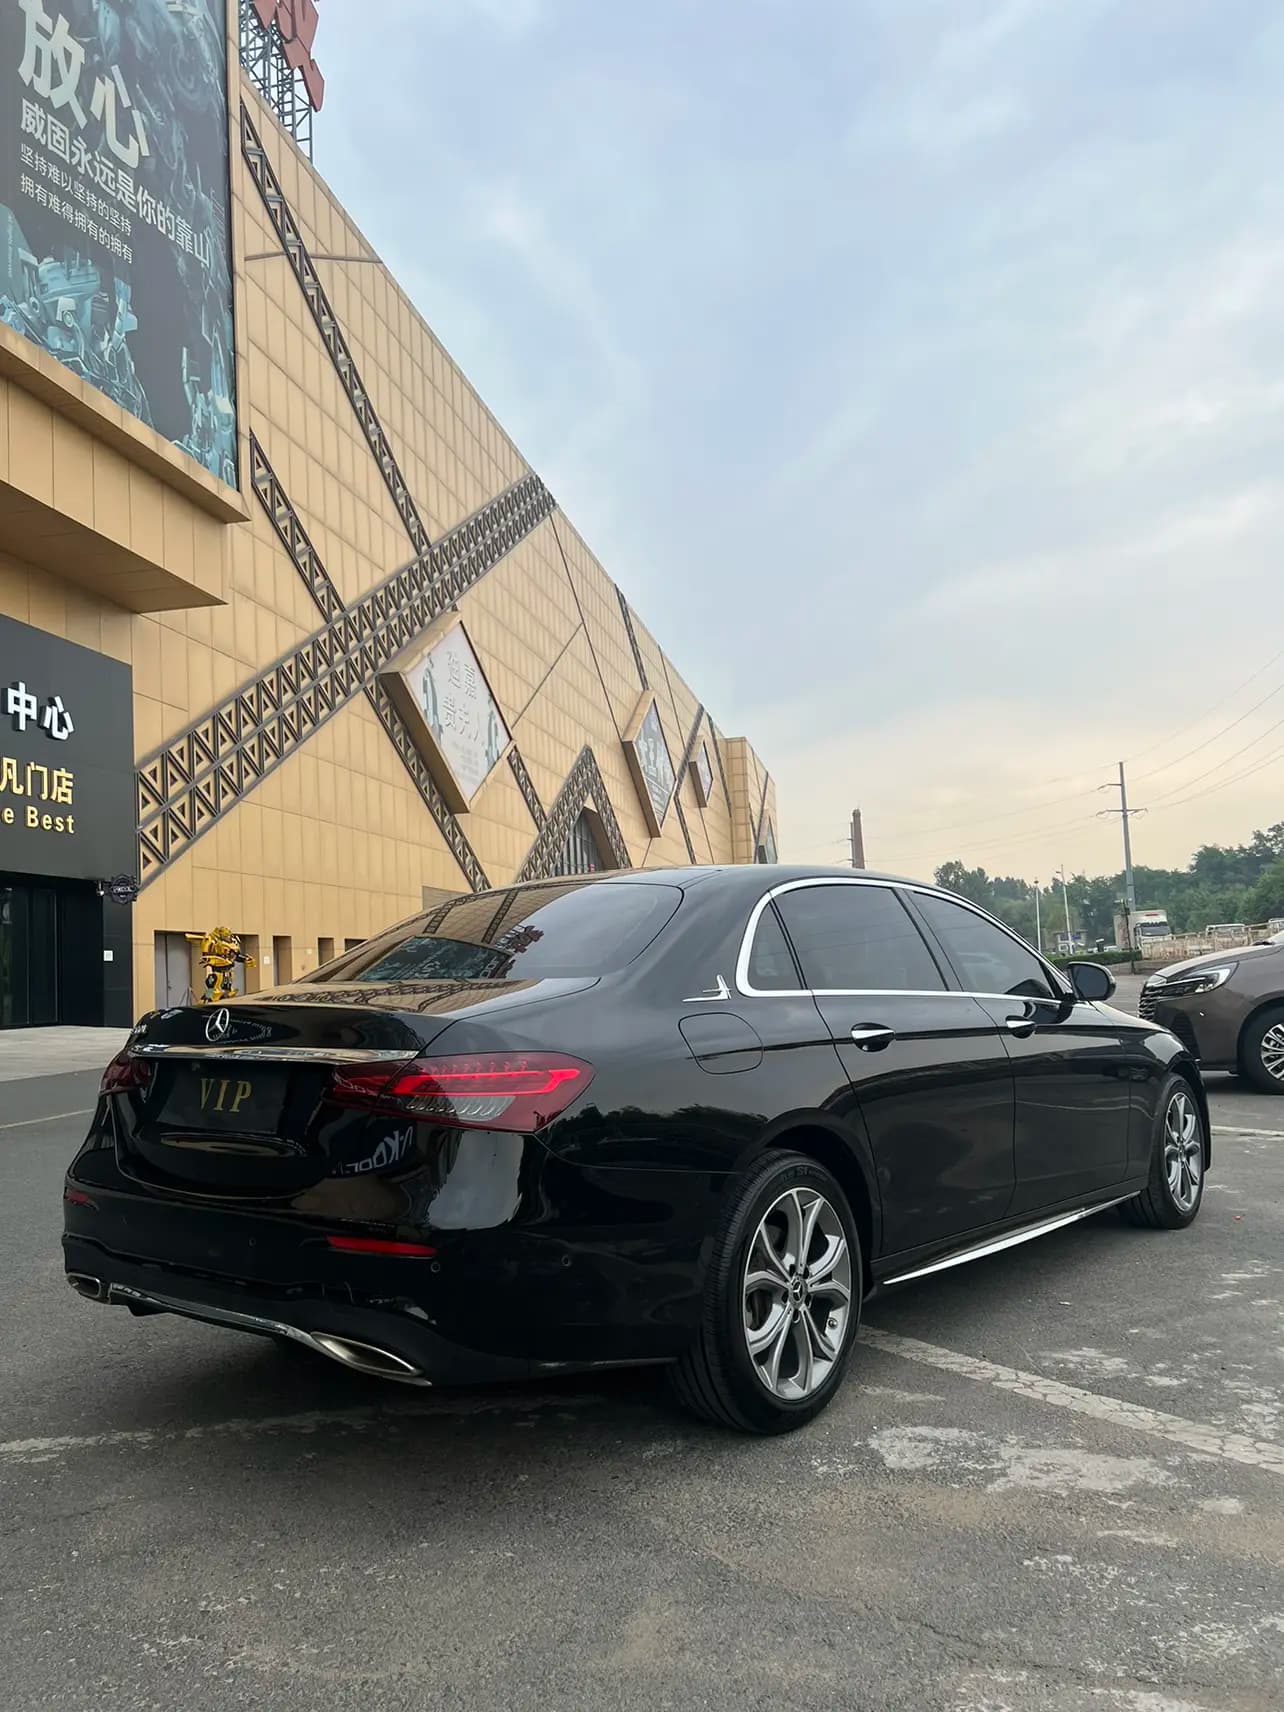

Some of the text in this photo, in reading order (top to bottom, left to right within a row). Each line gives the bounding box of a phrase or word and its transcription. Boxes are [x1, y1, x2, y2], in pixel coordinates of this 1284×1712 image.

[18, 0, 150, 168] 放心
[20, 98, 210, 268] 威固永远是你的靠山
[20, 143, 132, 236] 坚持难以坚持的坚持
[20, 173, 133, 264] 拥有难得拥有的拥有
[7, 681, 75, 741] 中心
[0, 756, 75, 805] 凡门店
[26, 805, 75, 834] Best
[200, 1078, 252, 1112] VIP
